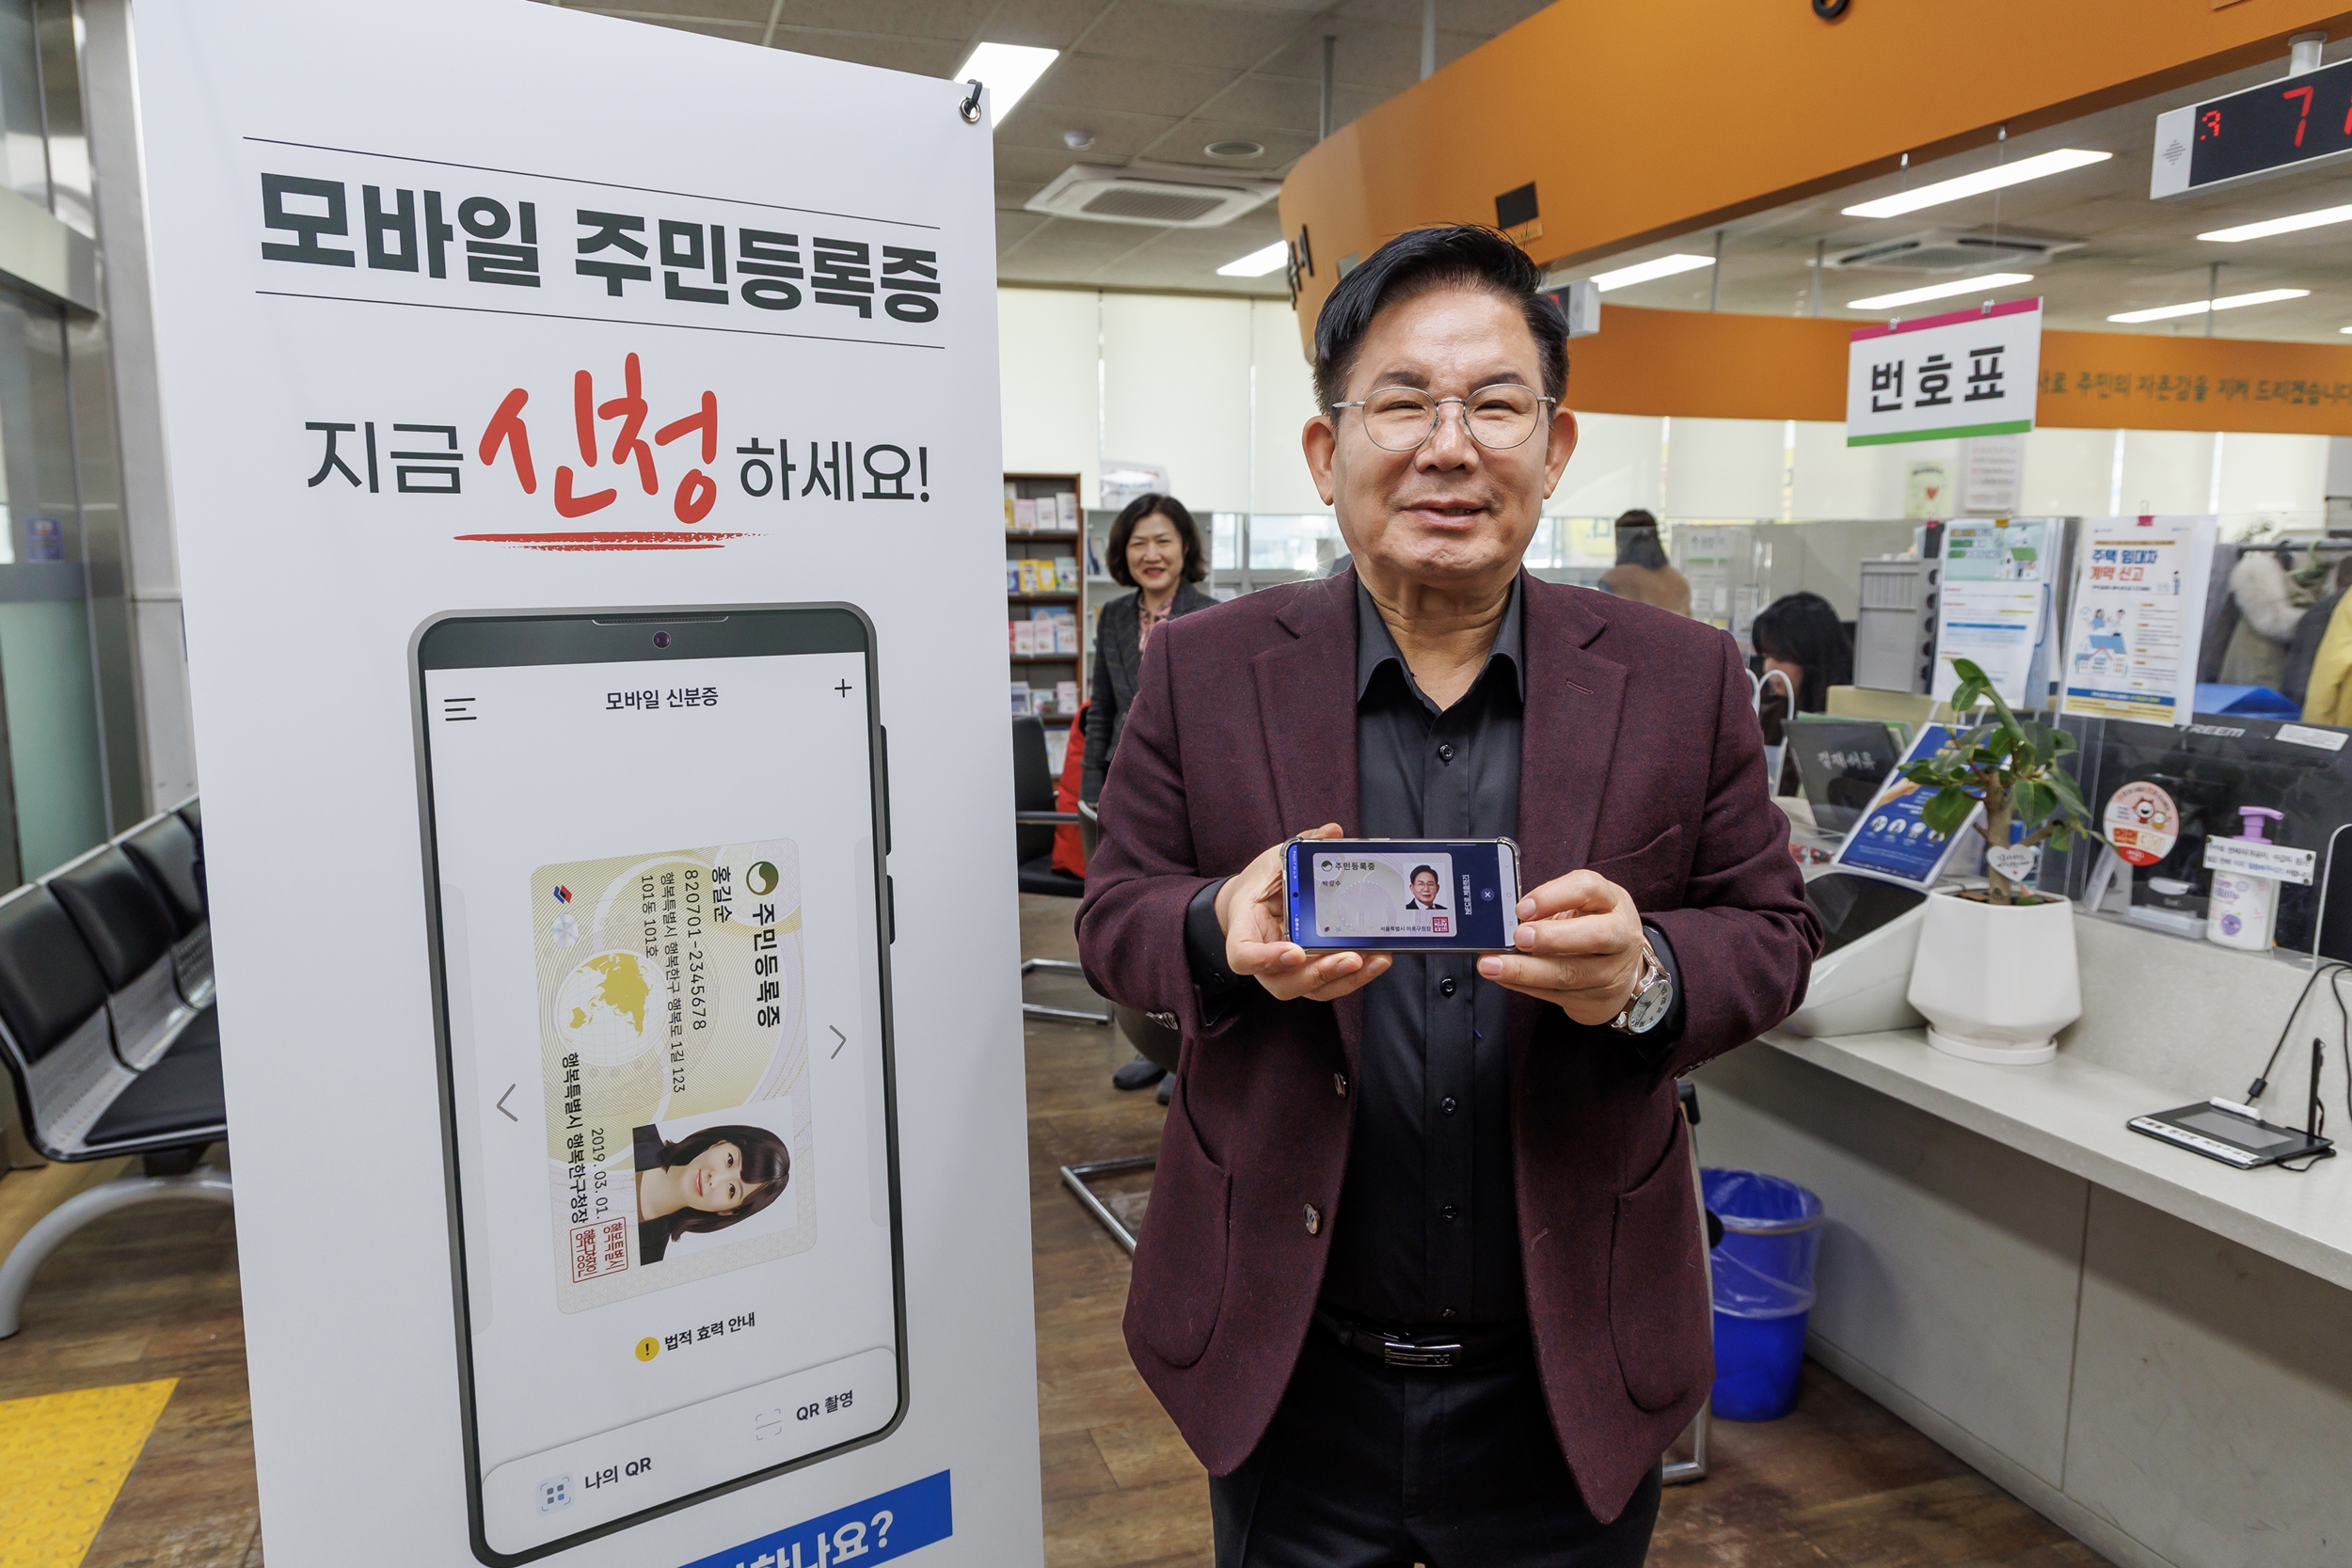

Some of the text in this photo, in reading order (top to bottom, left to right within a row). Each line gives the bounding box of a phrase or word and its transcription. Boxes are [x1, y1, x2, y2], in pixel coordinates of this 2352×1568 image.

[2282, 85, 2352, 149] 7
[260, 172, 942, 324] 모바일 주민등록증
[1870, 344, 2006, 414] 번호표
[305, 352, 930, 525] 지금 신청 하세요!
[2092, 549, 2118, 563] 주택
[2120, 566, 2144, 581] 신고
[605, 686, 719, 712] 모바일 신분증
[711, 865, 732, 923] 홍길순
[1335, 862, 1375, 871] 주민등록증
[642, 875, 659, 958] 101동 101호
[684, 870, 707, 1030] 820701-2345678
[753, 903, 781, 1029] 주민등록증
[660, 871, 685, 1094] 행복특별시 행복한구 행복로 1길 123
[562, 1052, 589, 1224] 행복특별시 행복한구청장
[591, 1128, 608, 1219] 2019. 03. 01.
[603, 1222, 625, 1270] 행복특별시
[664, 1312, 755, 1351] 법적 효력 안내
[796, 1390, 853, 1422] QR 촬영
[584, 1457, 652, 1490] 나의 QR
